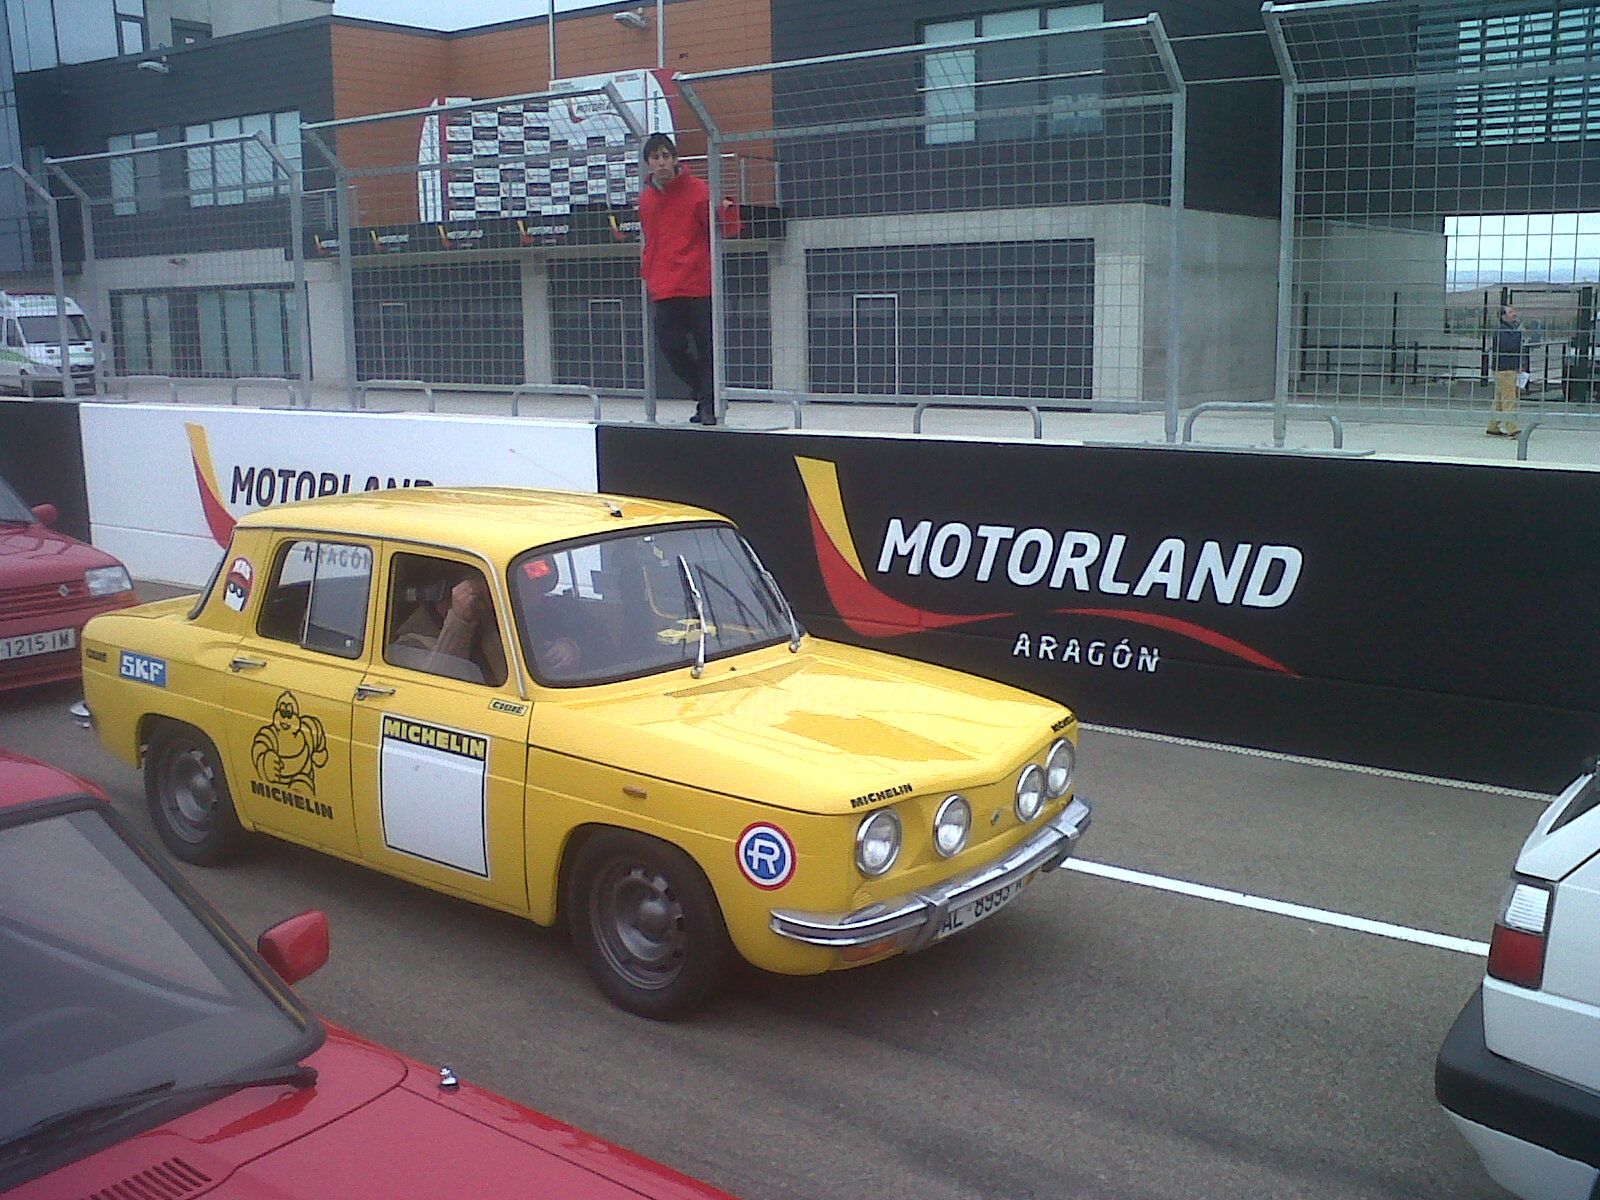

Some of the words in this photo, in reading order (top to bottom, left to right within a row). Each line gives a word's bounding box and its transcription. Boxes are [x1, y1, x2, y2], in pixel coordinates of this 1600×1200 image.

[877, 518, 1303, 608] MOTORLAND
[120, 654, 164, 682] SKF
[1012, 633, 1160, 673] ARAGÓN
[383, 718, 486, 757] MICHELIN
[250, 780, 334, 820] MICHELIN
[850, 783, 913, 808] MICHELIN
